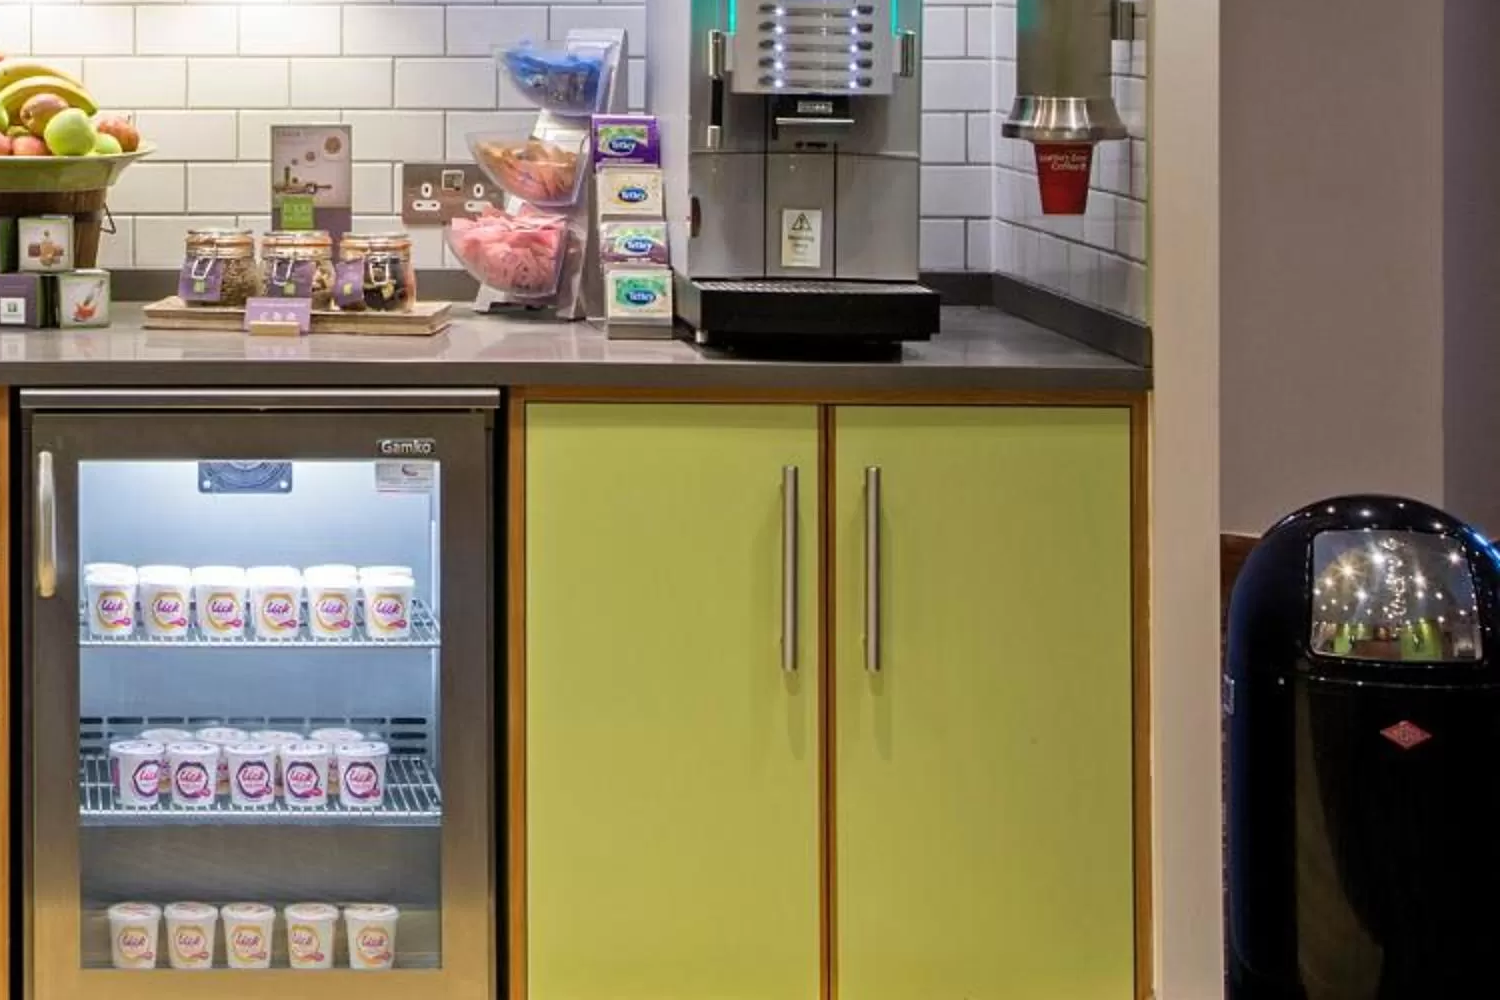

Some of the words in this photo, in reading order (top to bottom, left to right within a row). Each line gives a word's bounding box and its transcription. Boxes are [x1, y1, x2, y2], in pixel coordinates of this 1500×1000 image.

[627, 240, 653, 252] Tetley
[629, 291, 653, 302] Tetley
[381, 439, 431, 454] Gamko
